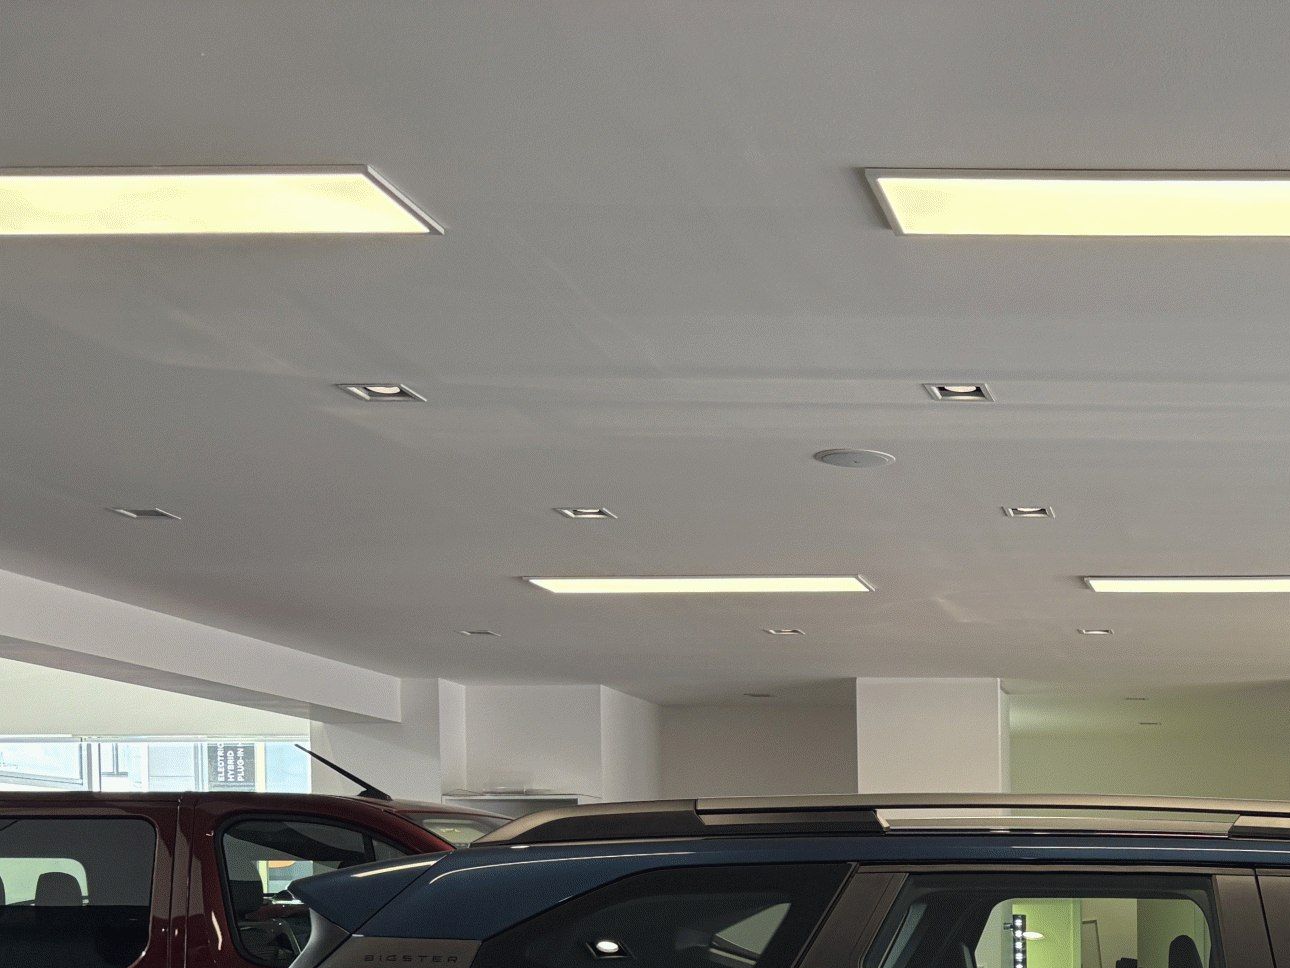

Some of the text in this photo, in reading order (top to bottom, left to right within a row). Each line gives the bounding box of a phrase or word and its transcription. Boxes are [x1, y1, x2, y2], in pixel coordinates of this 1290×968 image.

[227, 750, 235, 781] HYBRID
[237, 748, 245, 781] PLUG-IN
[364, 954, 458, 963] BIGSTER
